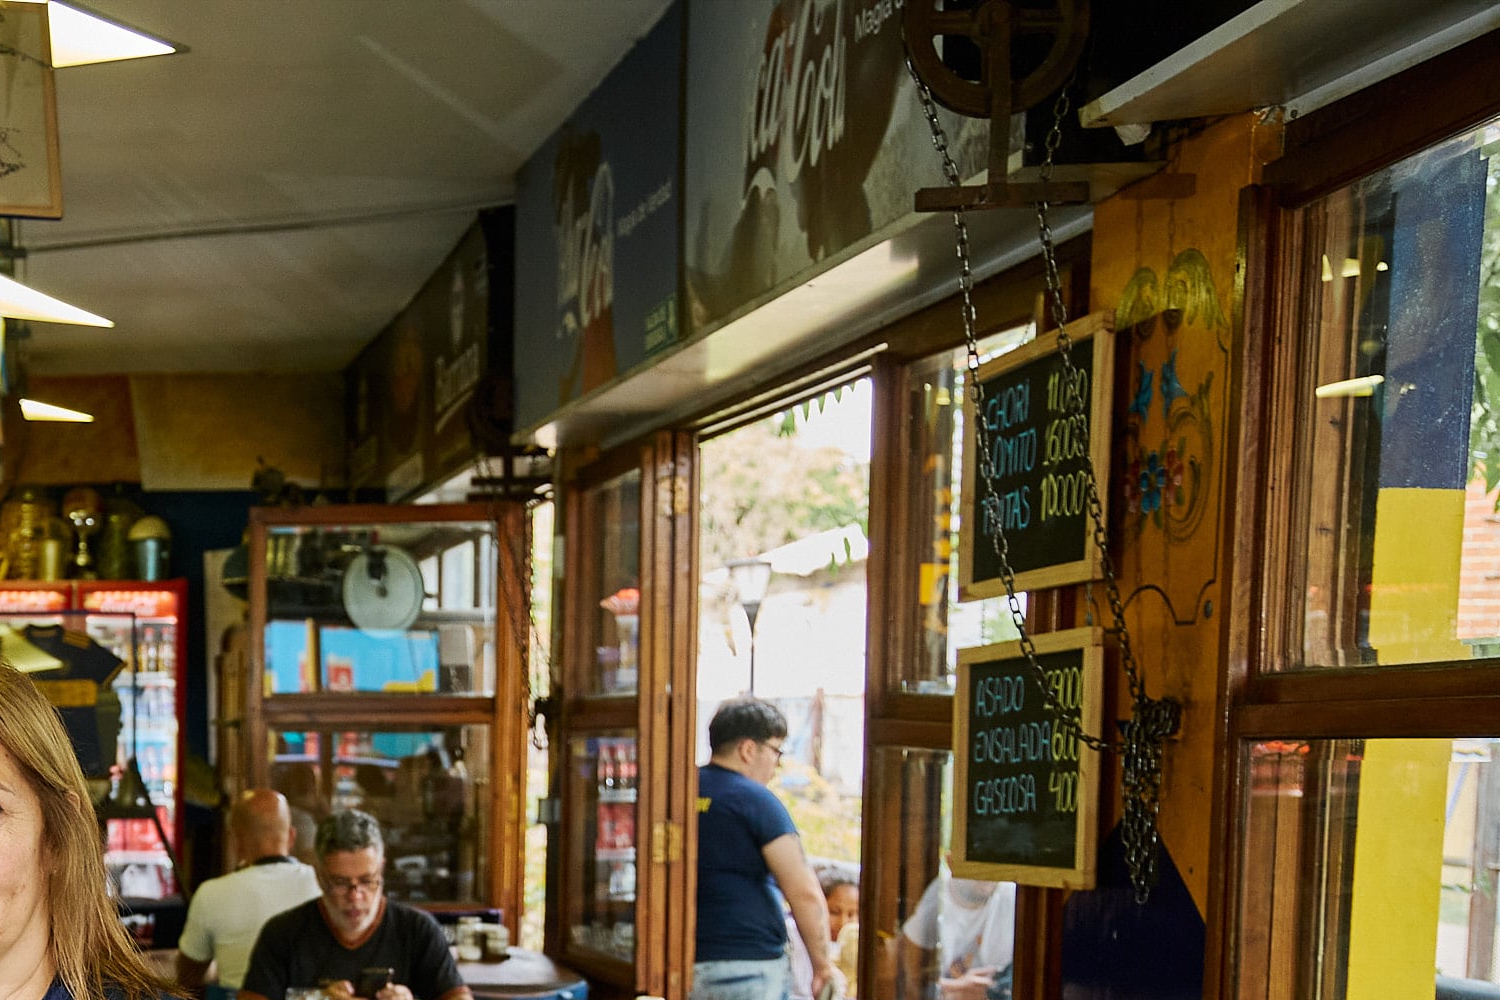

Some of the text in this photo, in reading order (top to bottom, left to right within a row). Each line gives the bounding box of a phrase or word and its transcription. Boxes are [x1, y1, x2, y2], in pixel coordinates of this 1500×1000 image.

[987, 379, 1030, 431] CHORI
[984, 427, 1037, 480] OMITO
[1040, 470, 1087, 522] 10000
[975, 675, 1025, 717] ASADO
[974, 720, 1050, 764] ENSALADA
[974, 773, 1036, 815] GASEOSA
